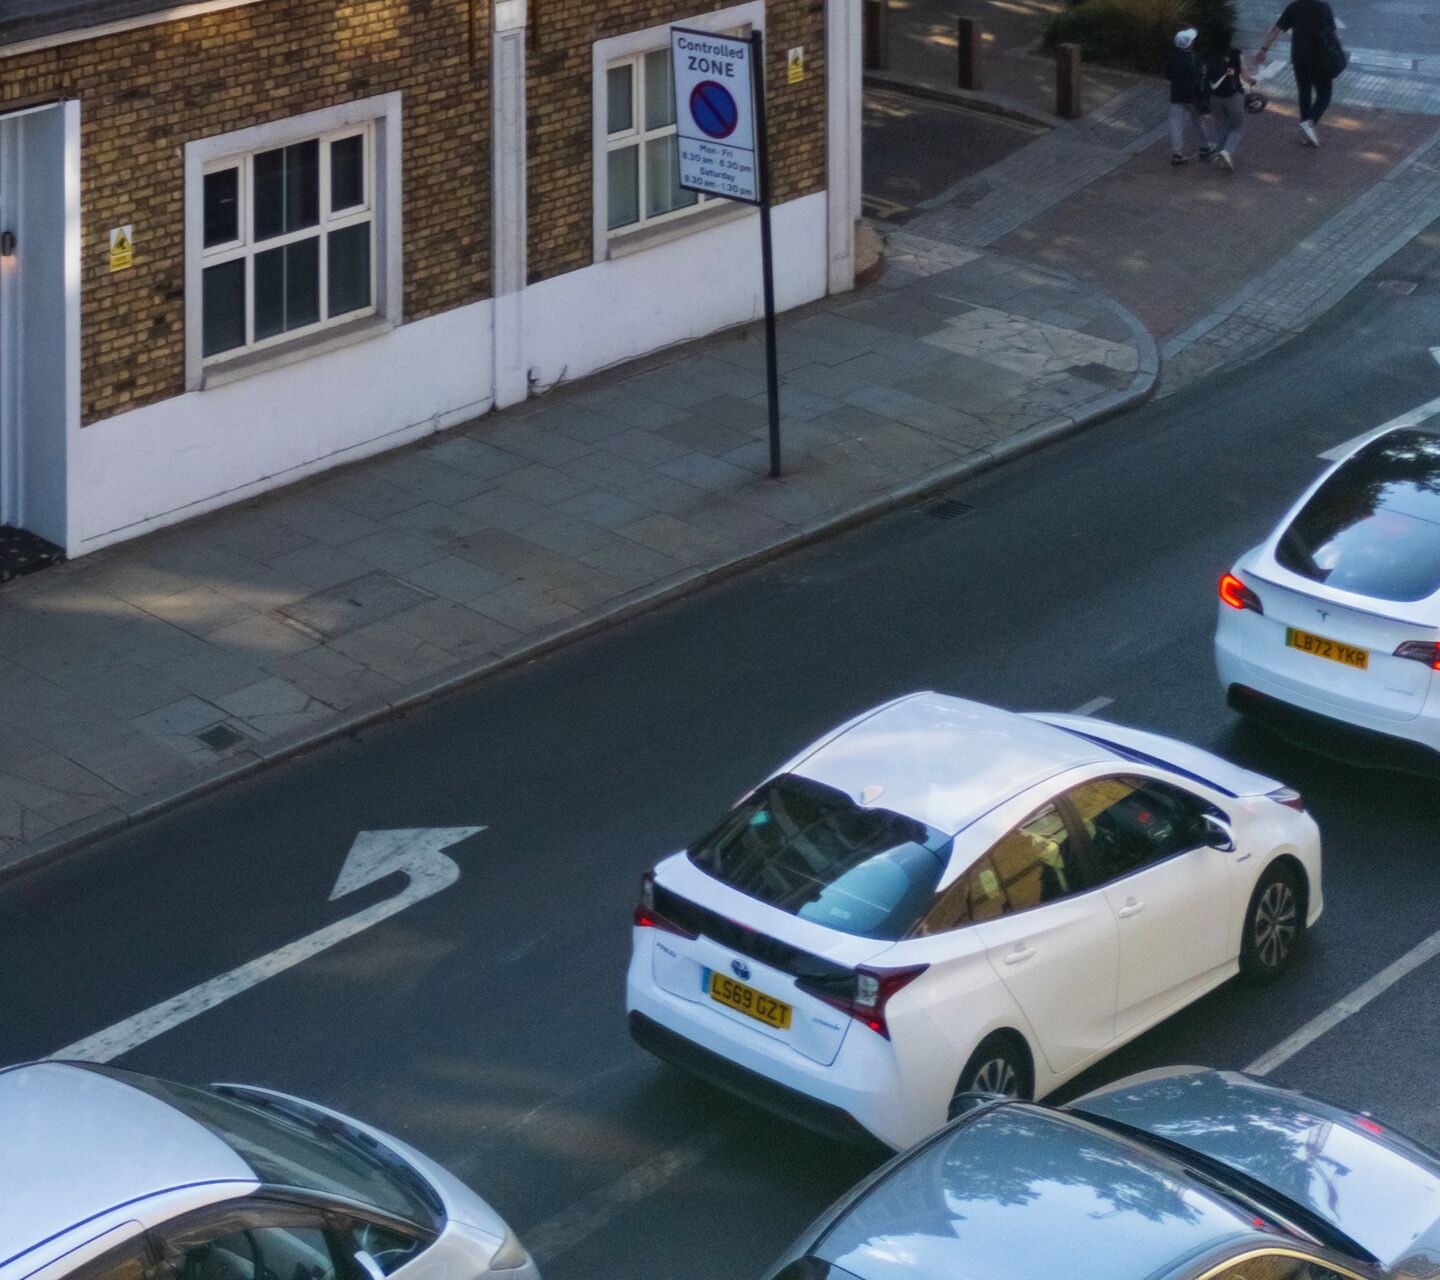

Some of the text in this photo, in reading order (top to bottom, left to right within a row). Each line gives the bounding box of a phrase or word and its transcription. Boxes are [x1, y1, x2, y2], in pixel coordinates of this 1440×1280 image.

[677, 37, 744, 60] Controlled
[688, 56, 735, 77] ZONE
[700, 167, 735, 183] Saturday
[712, 973, 789, 1025] LS69 GZT
